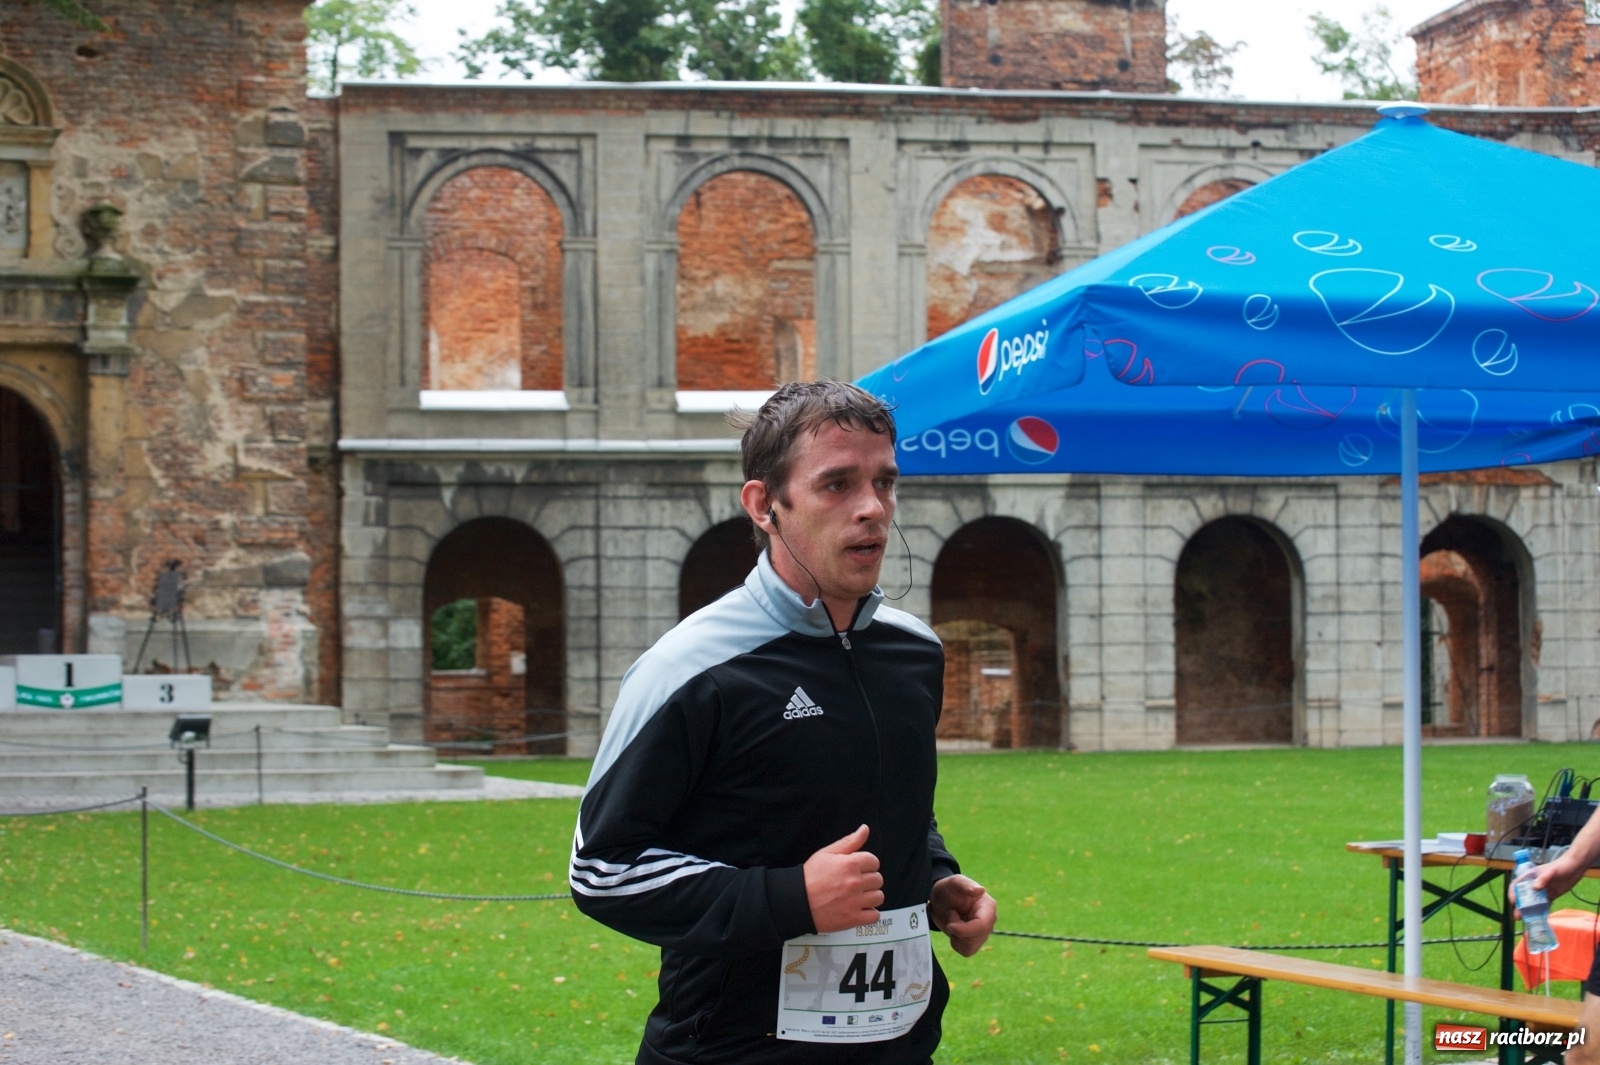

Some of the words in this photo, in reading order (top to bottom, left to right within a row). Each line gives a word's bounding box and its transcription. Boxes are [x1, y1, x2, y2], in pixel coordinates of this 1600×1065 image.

[998, 318, 1050, 382] pepsi
[64, 662, 75, 687] 1
[160, 683, 175, 703] 3
[783, 705, 824, 720] adidas
[855, 925, 889, 937] 19.09.2021
[839, 949, 896, 1003] 44
